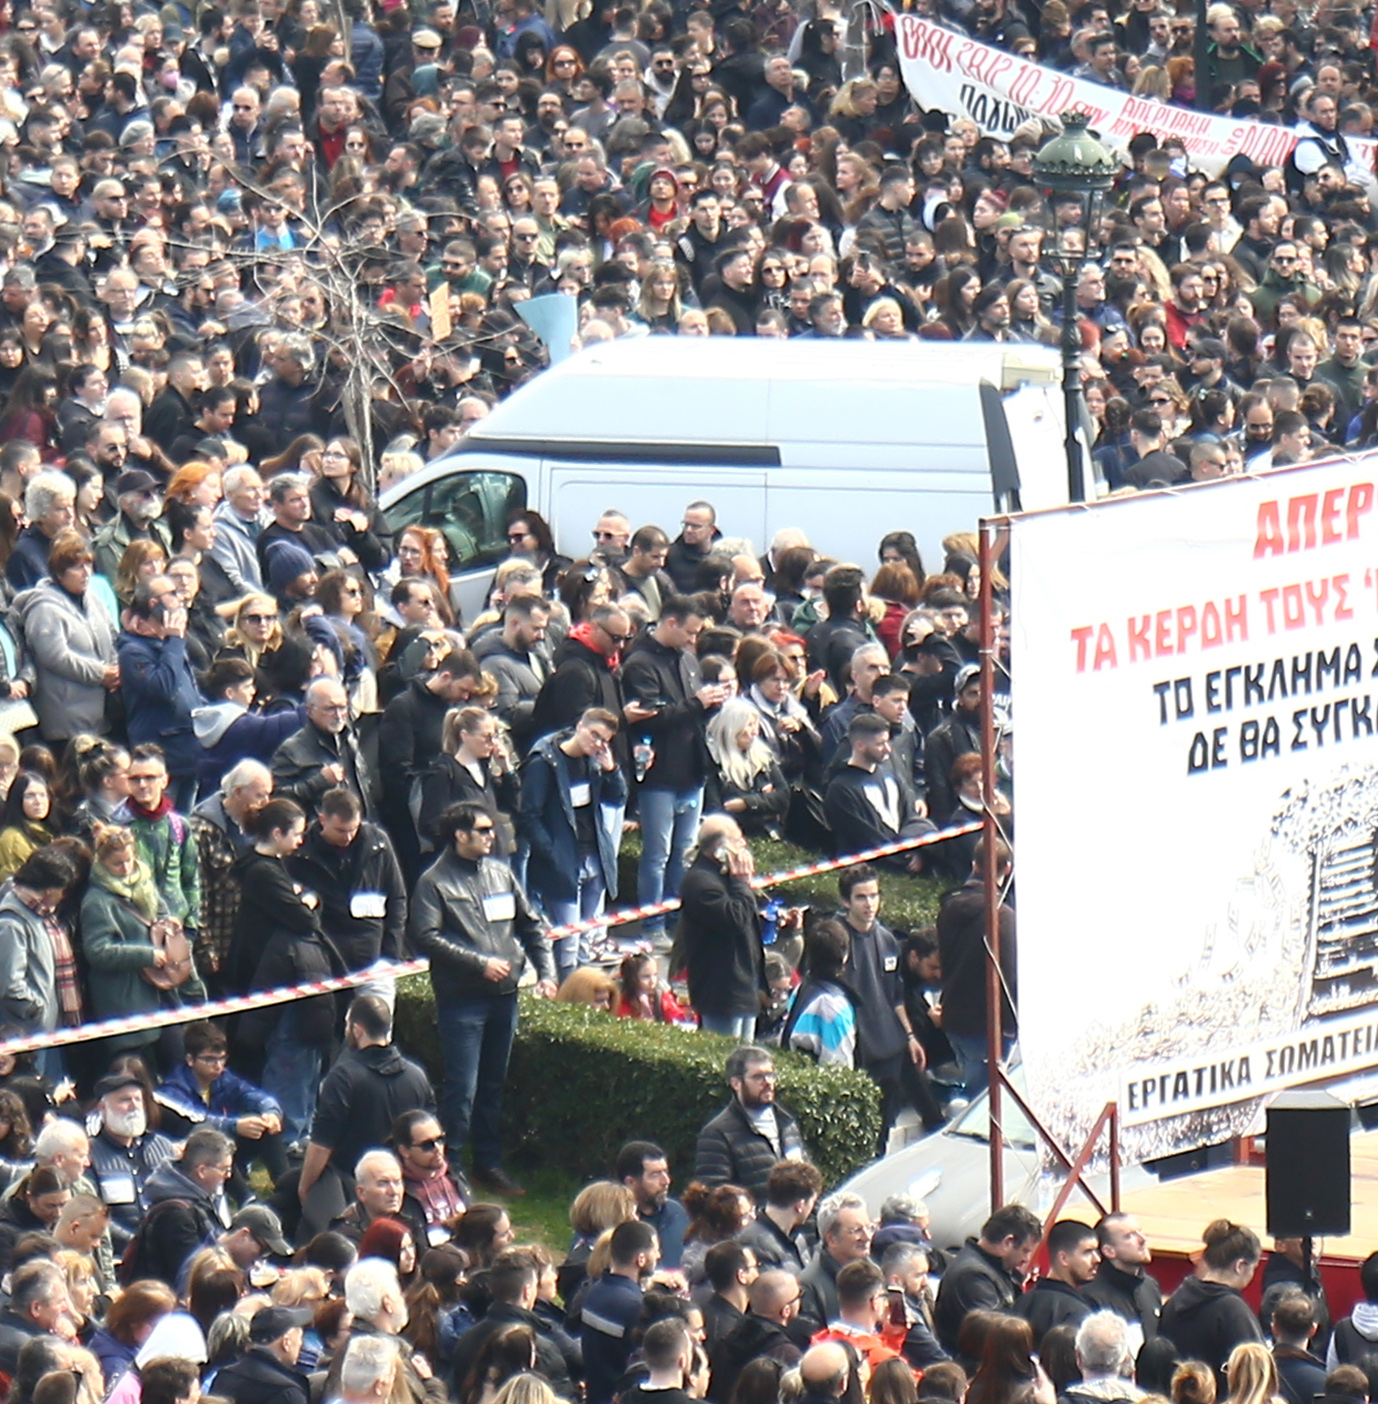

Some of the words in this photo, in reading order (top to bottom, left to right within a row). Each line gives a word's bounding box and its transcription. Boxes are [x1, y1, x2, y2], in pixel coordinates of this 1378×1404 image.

[1070, 621, 1119, 673] ΤΑ
[1127, 592, 1249, 661] ΚΕΡΔΗ
[1259, 573, 1354, 634] ΤΟΥΣ
[1153, 680, 1195, 725] ΤΟ
[1205, 642, 1362, 715] ΕΓΚΛΗΜΑ
[1186, 726, 1228, 776] ΔΕ
[1240, 714, 1281, 764] ΘΑ
[1127, 1055, 1252, 1114] ΕΡΓΑΤΙΚΑ
